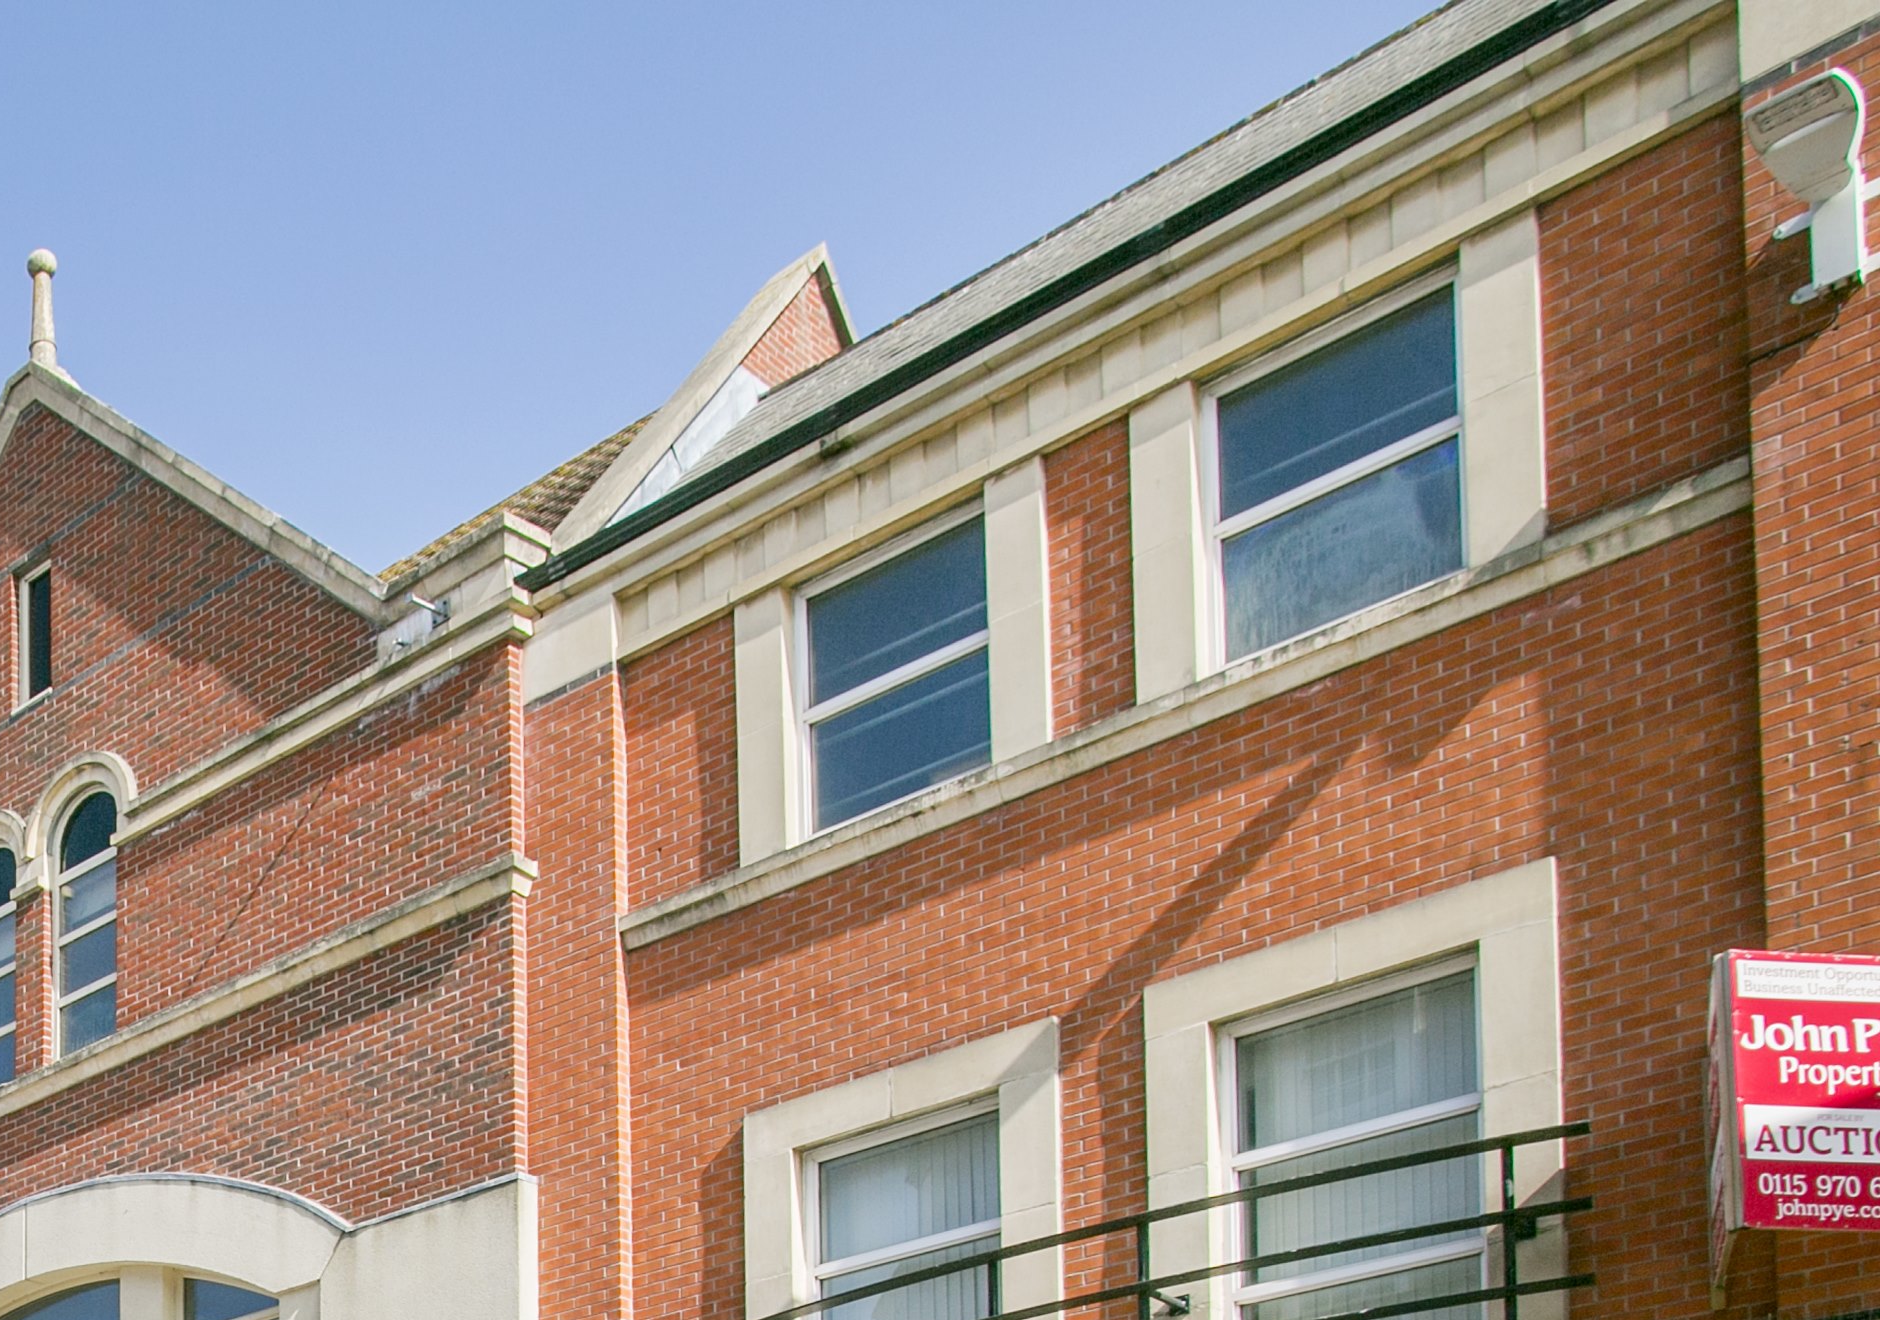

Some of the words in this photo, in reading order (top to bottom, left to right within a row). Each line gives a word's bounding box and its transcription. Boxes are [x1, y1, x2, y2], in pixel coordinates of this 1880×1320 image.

[1743, 963, 1821, 980] Investment
[1744, 979, 1804, 994] Business
[1740, 1014, 1851, 1052] John
[1753, 1124, 1880, 1156] AUCTI
[1759, 1172, 1808, 1196] 0115
[1816, 1174, 1861, 1198] 970
